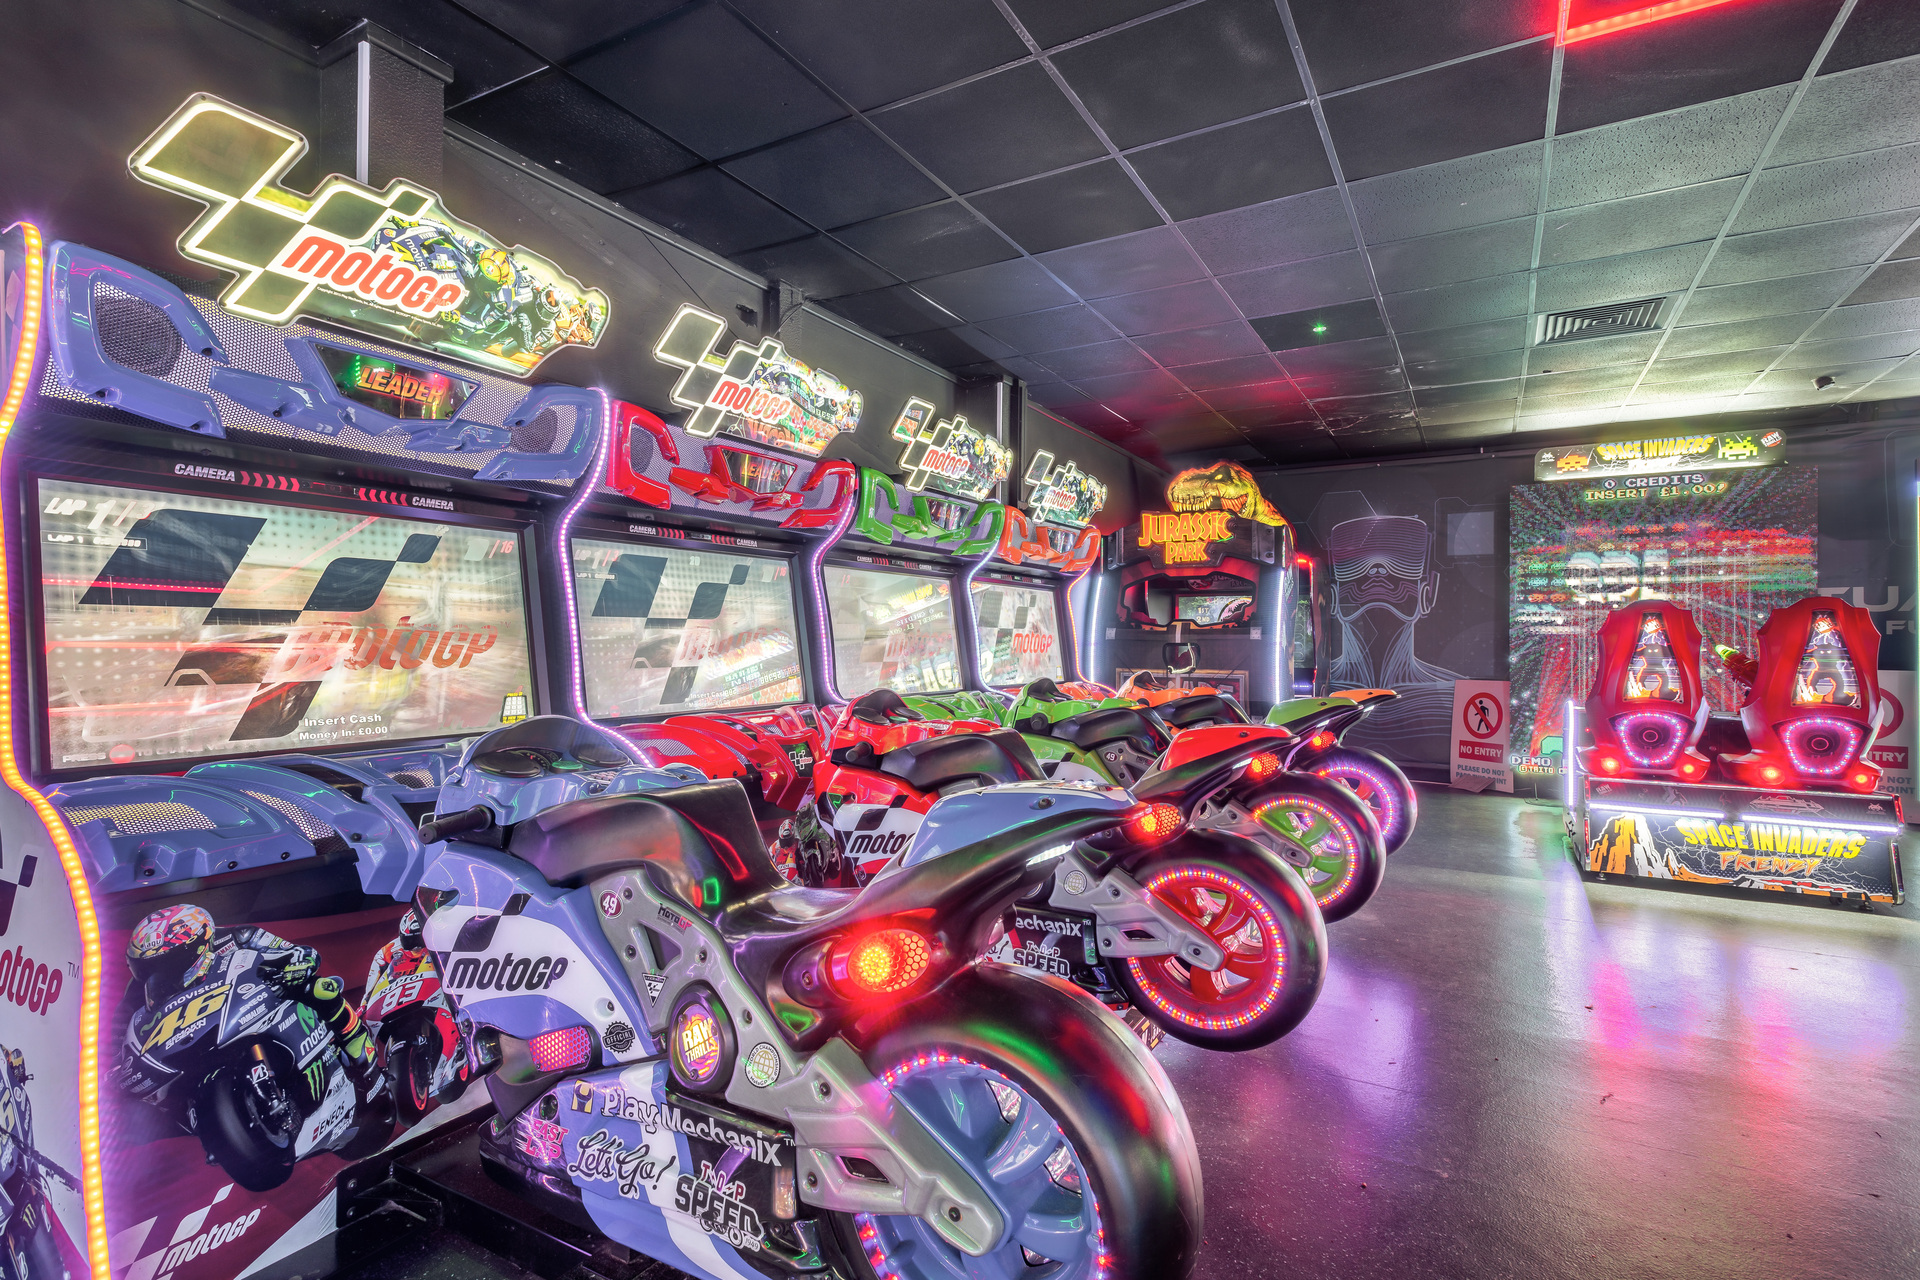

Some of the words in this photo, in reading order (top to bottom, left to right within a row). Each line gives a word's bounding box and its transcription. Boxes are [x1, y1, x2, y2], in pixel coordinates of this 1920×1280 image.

[360, 368, 445, 404] LEADER
[1597, 440, 1642, 461] SPACE
[1643, 434, 1715, 457] INVADERS
[174, 463, 236, 482] CAMERA
[412, 496, 454, 510] CAMERA
[1585, 488, 1648, 501] INSERT
[1659, 482, 1727, 498] £1.00!
[1625, 473, 1705, 488] CREDITS
[43, 497, 87, 516] LAP
[629, 525, 657, 535] CAMERA
[736, 538, 758, 548] CAMERA
[1138, 511, 1232, 547] JURASSIC
[1165, 541, 1208, 565] PARK
[1012, 631, 1053, 654] motoGP
[304, 715, 346, 727] Insert
[349, 713, 382, 724] Cash
[299, 730, 338, 741] Money
[341, 728, 356, 737] In:
[358, 726, 388, 736] £0.00
[1106, 752, 1116, 761] 49
[1460, 744, 1473, 754] NO
[1474, 746, 1502, 758] ENTRY
[1511, 755, 1552, 767] DEMO
[1867, 751, 1906, 763] NTRY
[1457, 764, 1480, 773] PLEASE
[1481, 766, 1491, 774] DO
[1492, 768, 1505, 777] NOT
[1887, 776, 1912, 785] NOT
[1878, 785, 1916, 795] POINT
[849, 831, 915, 855] moto
[1675, 817, 1749, 851] SPACE
[1750, 822, 1867, 859] INVADERS
[1719, 850, 1823, 876] FRENZY
[602, 895, 618, 914] 49
[1015, 915, 1082, 938] echanix
[217, 942, 236, 956] AMAHA
[446, 952, 569, 992] motoGP
[1013, 947, 1070, 978] SPEED
[164, 979, 224, 1013] movistar
[379, 973, 425, 997] REPSOL
[239, 991, 269, 1013] ENEOS
[380, 980, 424, 1016] 93
[140, 984, 233, 1055] 46
[606, 1031, 632, 1045] OFFICIAL
[682, 1017, 714, 1052] RAW
[685, 1036, 719, 1064] THRILLS
[532, 1119, 570, 1145] FAST
[601, 1088, 661, 1135] Play
[660, 1103, 782, 1168] Mechanix
[615, 1143, 677, 1196] Go!
[674, 1174, 764, 1240] SPEED
[157, 1208, 261, 1276] motoGP
[745, 1237, 761, 1251] 1949
